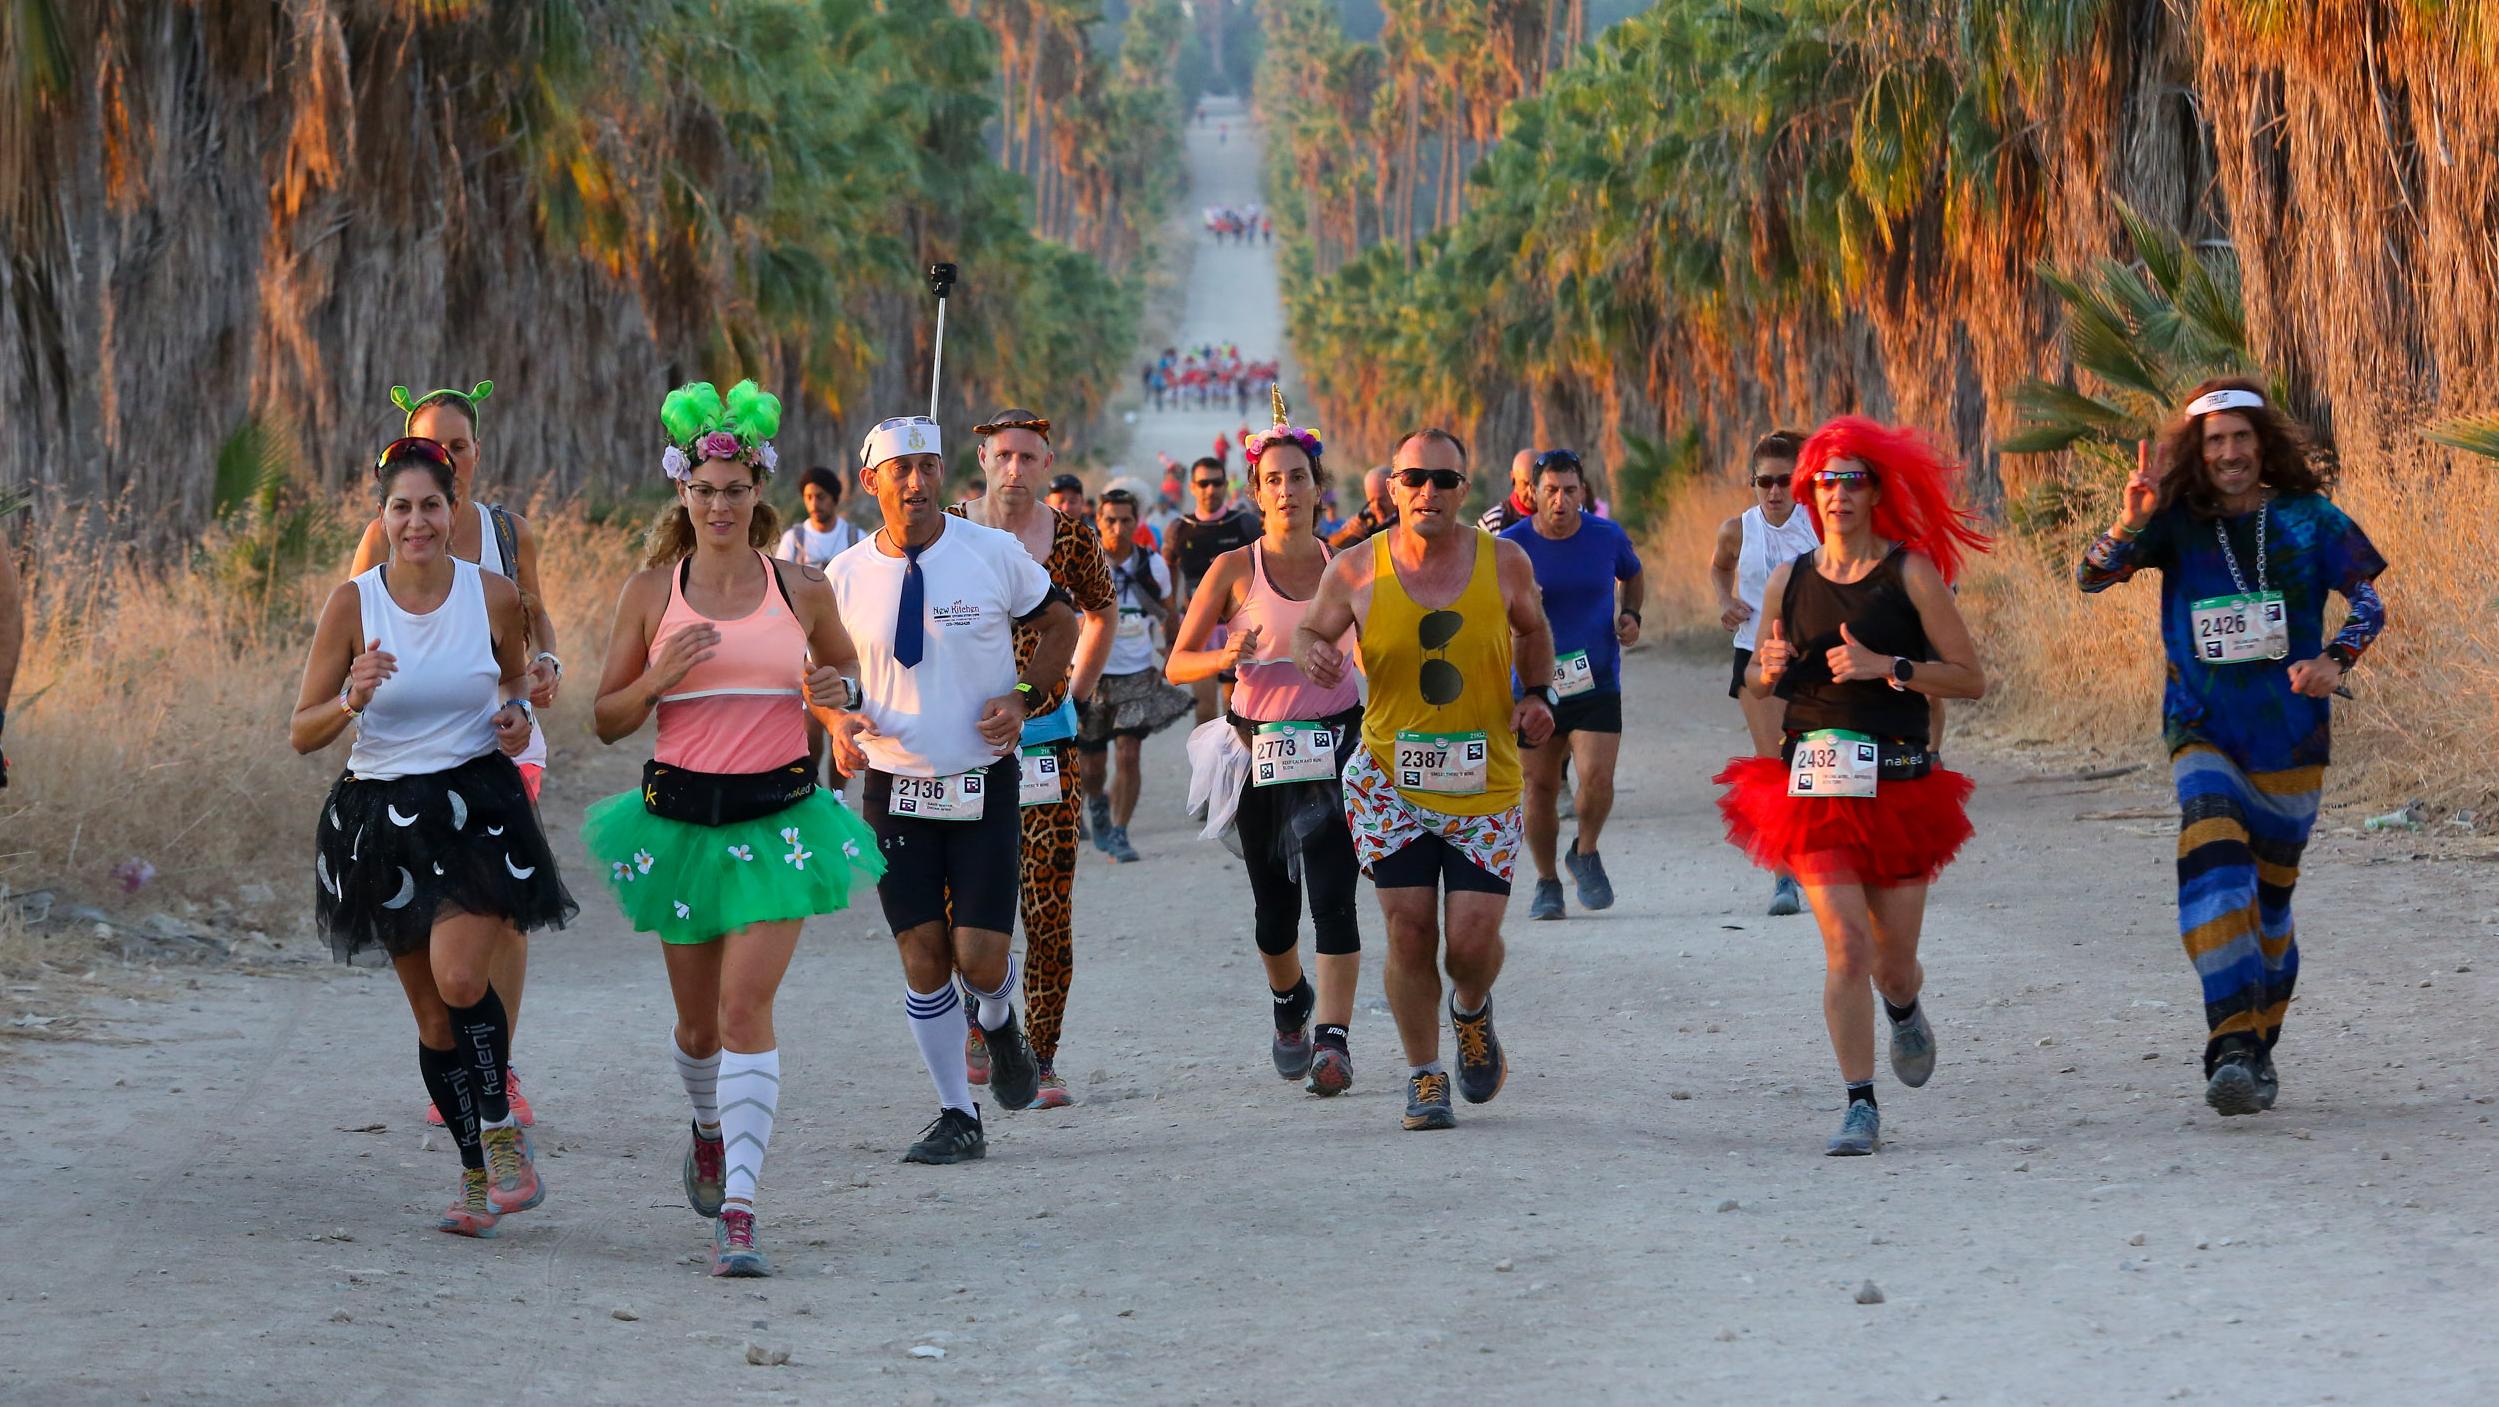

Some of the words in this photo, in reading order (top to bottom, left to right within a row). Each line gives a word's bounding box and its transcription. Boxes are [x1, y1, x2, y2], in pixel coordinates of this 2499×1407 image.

[933, 606, 950, 615] New
[951, 604, 980, 614] Kitchen
[2201, 614, 2246, 637] 2426
[1257, 739, 1296, 760] 2773
[1401, 750, 1447, 768] 2387
[1797, 749, 1837, 769] 2432
[1884, 752, 1924, 767] naked
[783, 782, 812, 802] naked
[899, 779, 945, 799] 2136
[464, 1022, 501, 1096] kalenji
[441, 1067, 480, 1148] kalenji
